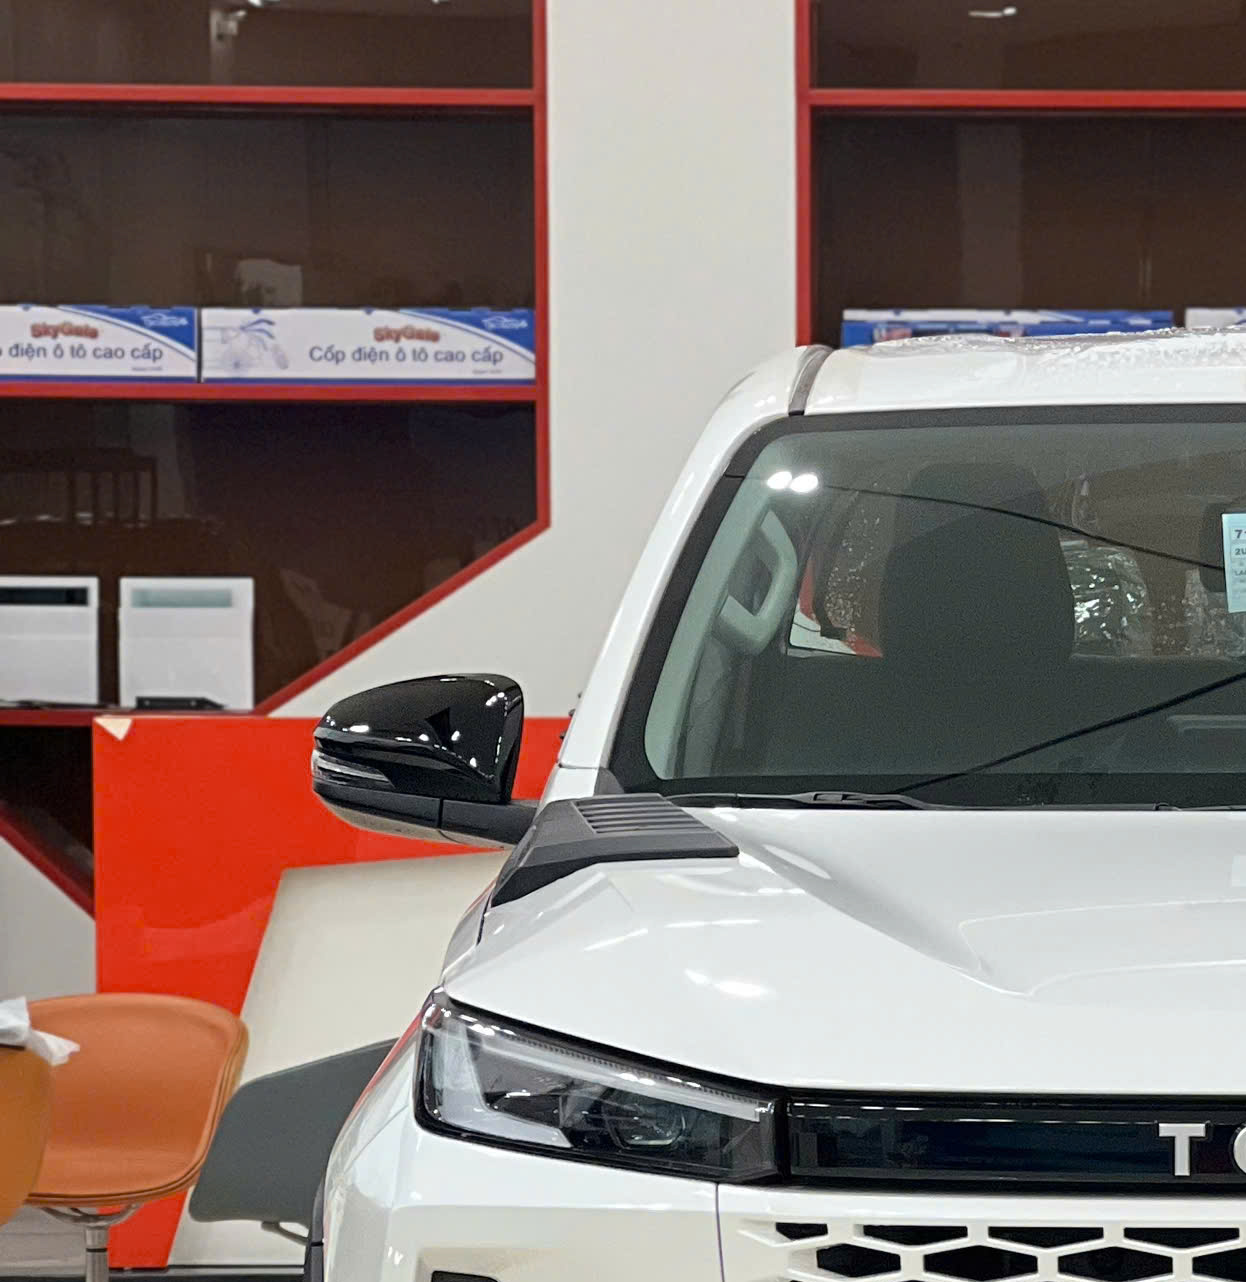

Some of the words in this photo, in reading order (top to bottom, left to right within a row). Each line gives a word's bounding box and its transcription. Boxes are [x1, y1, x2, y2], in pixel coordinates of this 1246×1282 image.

[8, 343, 47, 361] điện
[53, 342, 65, 360] ô
[70, 343, 88, 360] tô
[92, 348, 125, 360] cao
[130, 342, 164, 363] cấp
[308, 345, 346, 365] Cốp
[351, 346, 390, 364] điện
[395, 347, 406, 362] ô
[412, 346, 428, 362] tô
[434, 351, 466, 362] cao
[471, 347, 503, 365] cấp
